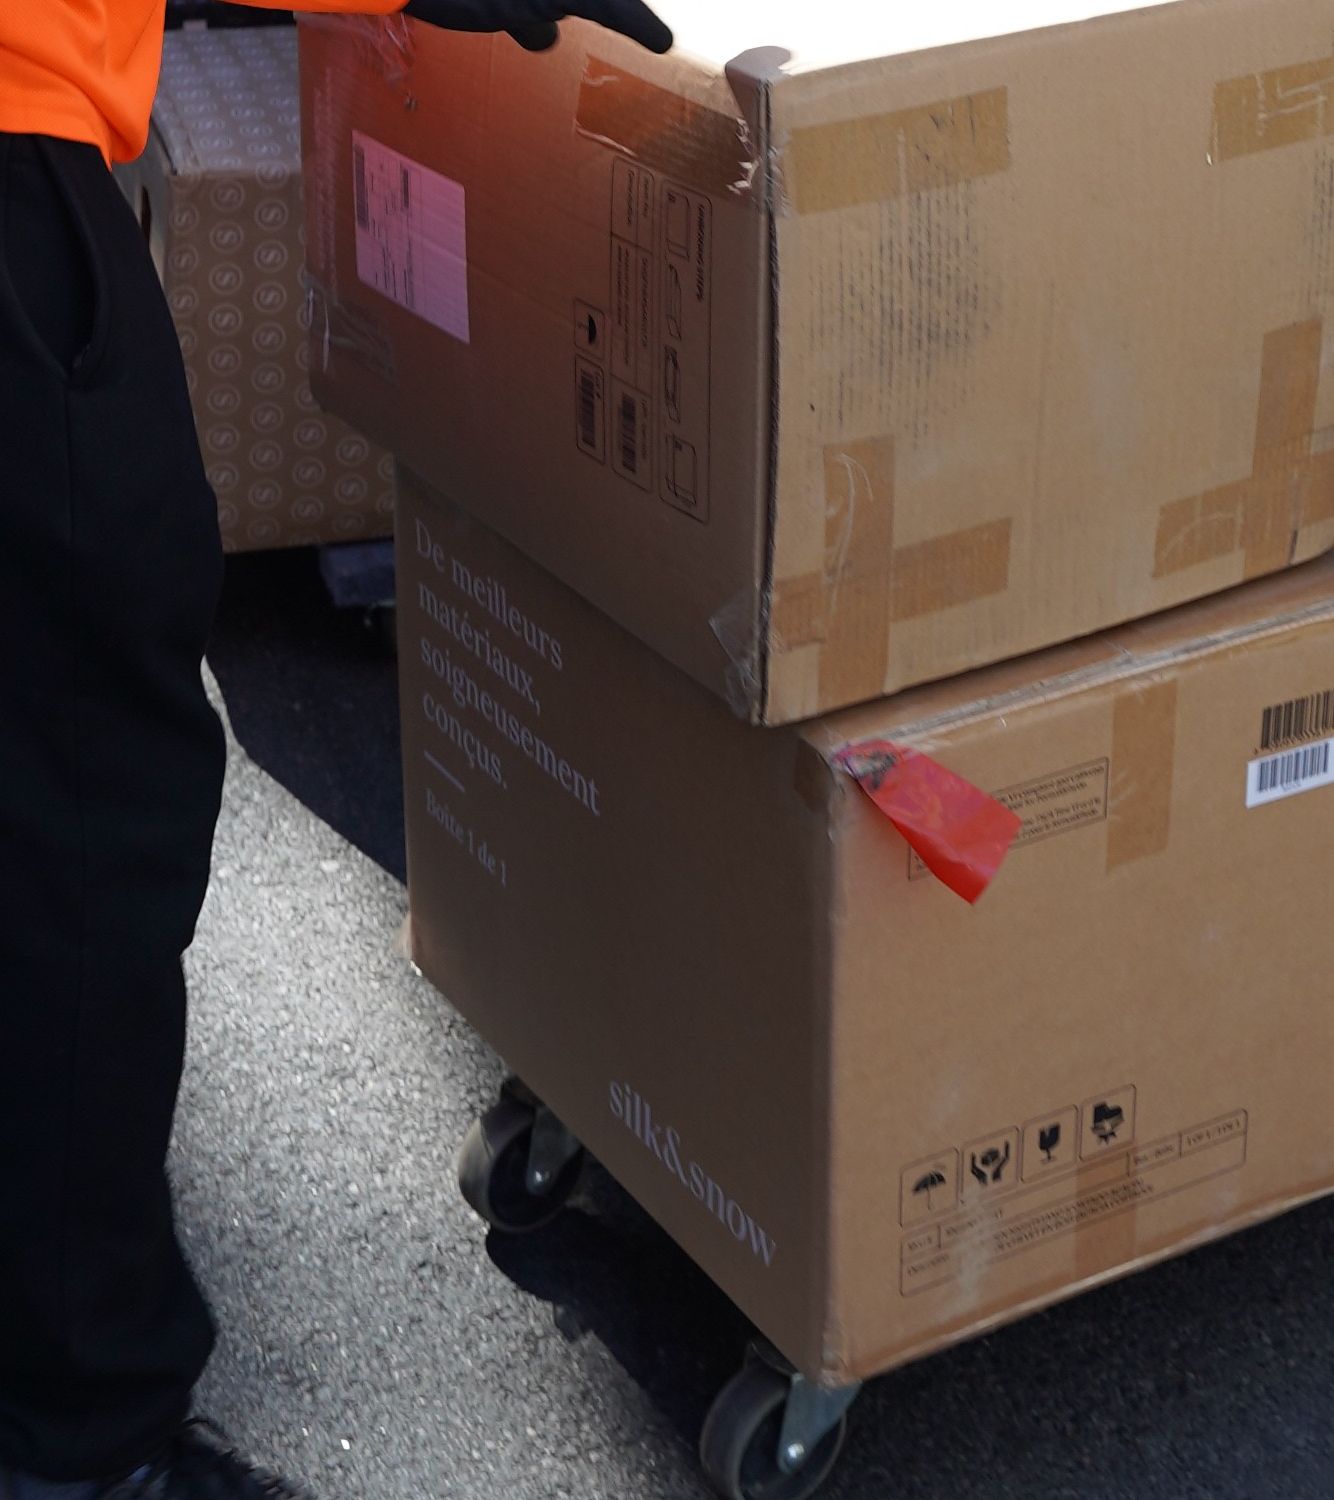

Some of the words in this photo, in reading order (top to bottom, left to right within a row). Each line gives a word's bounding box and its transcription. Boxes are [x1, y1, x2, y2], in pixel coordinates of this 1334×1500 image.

[414, 517, 445, 573] De
[452, 558, 564, 671] meilleurs
[418, 582, 541, 717] matériaux,
[420, 636, 601, 817] soigneusement
[422, 692, 508, 790] conçus.
[478, 840, 496, 876] de
